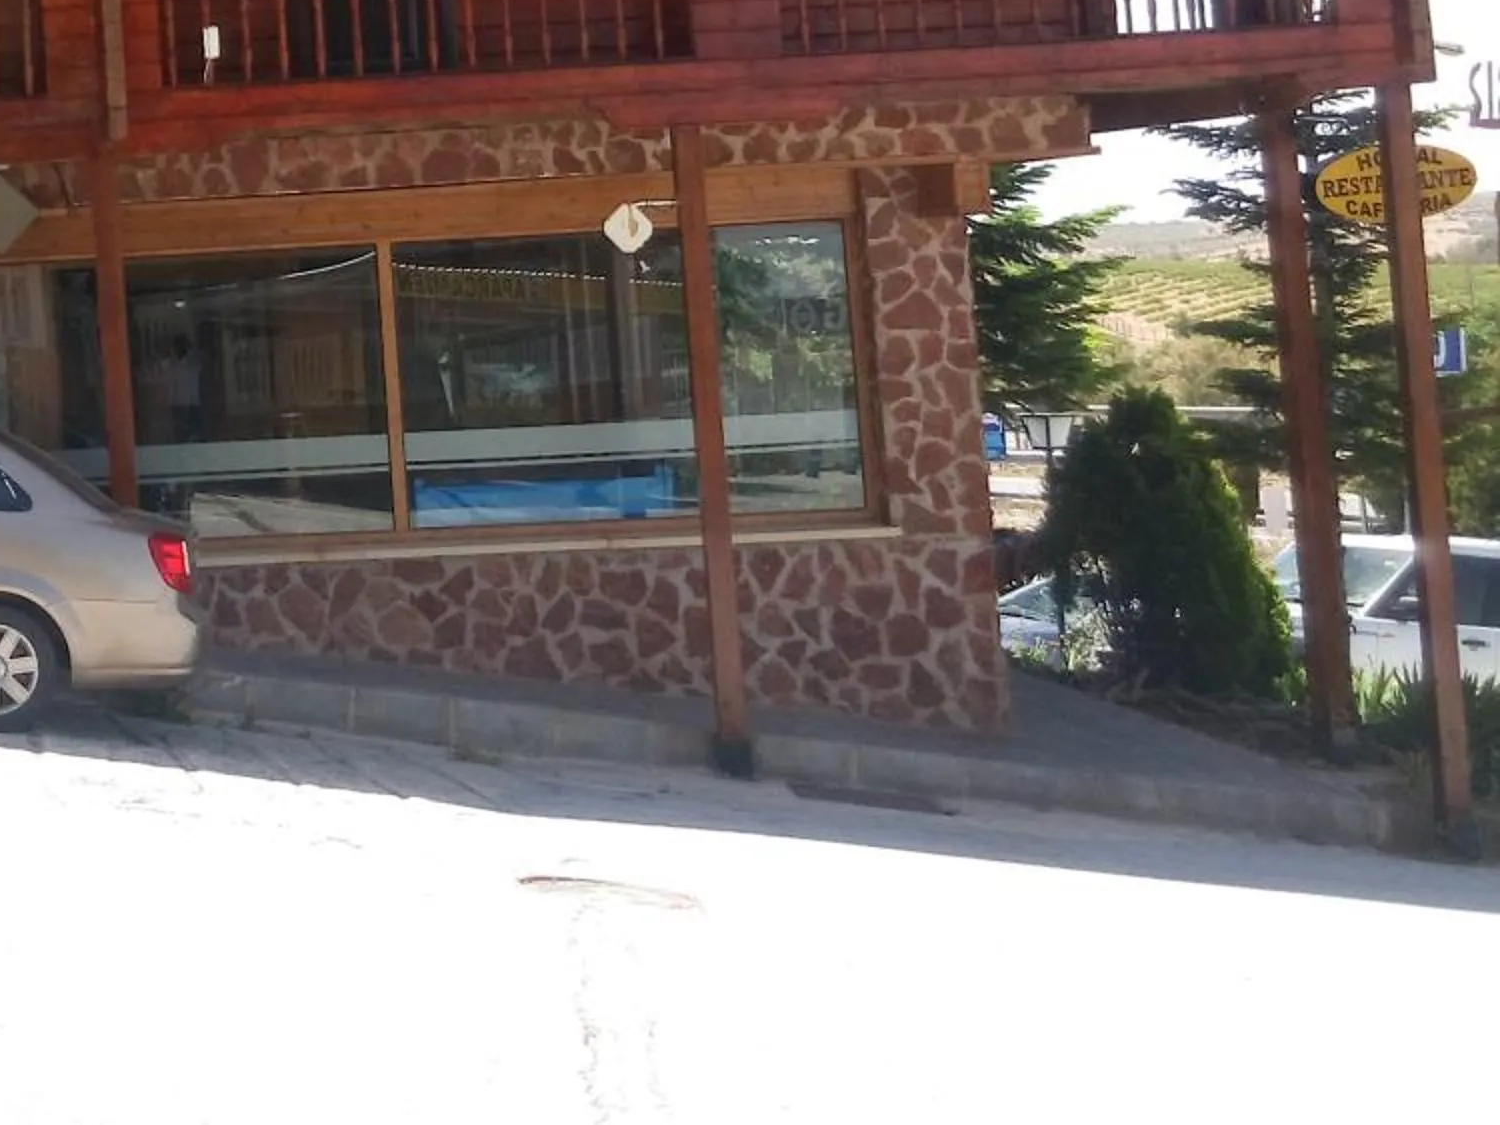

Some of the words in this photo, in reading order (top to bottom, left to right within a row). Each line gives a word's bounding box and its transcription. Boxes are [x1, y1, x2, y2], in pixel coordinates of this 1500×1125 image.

[1356, 147, 1442, 171] HOAL
[1322, 168, 1472, 197] RESTANTE
[1346, 193, 1452, 217] CAFRIA
